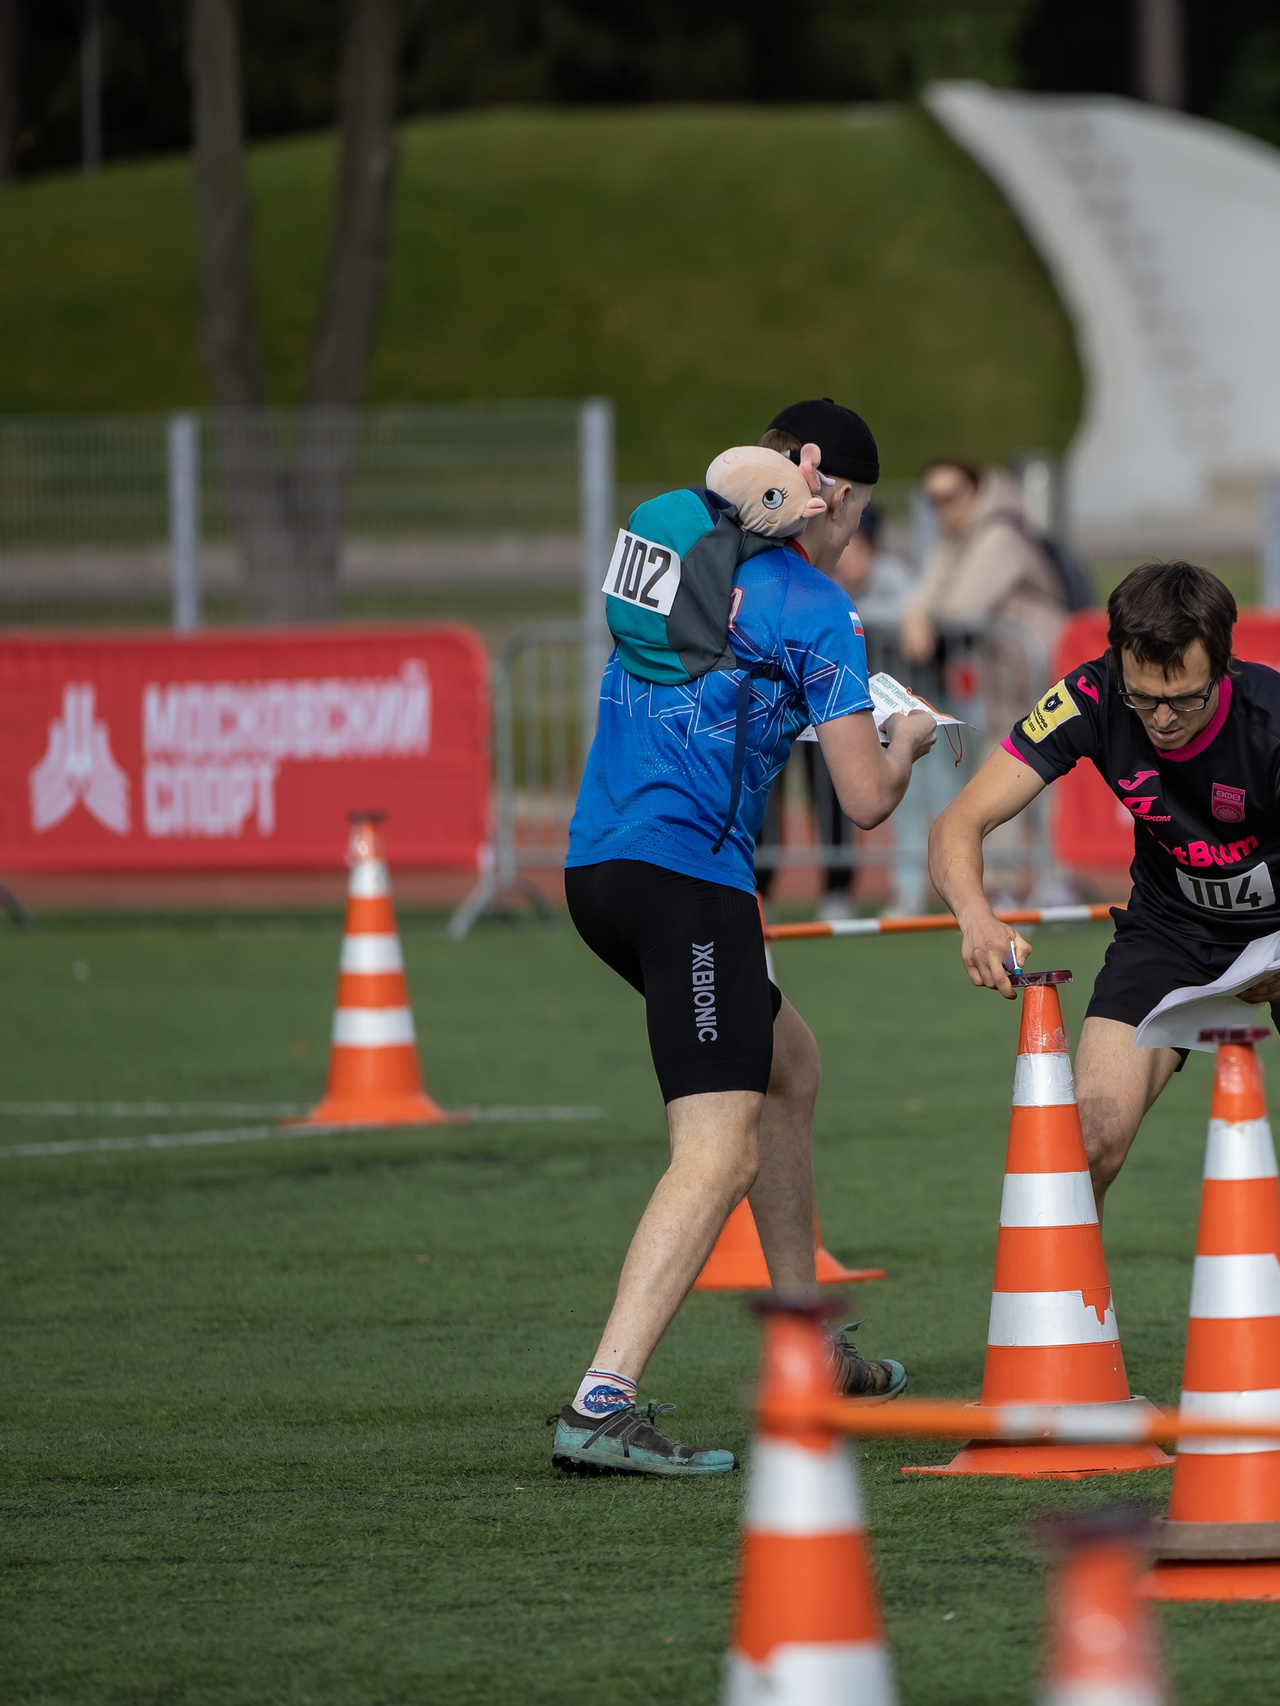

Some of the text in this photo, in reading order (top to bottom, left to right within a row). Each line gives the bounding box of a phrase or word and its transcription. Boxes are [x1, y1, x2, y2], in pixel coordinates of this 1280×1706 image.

[613, 535, 671, 608] 102
[144, 659, 430, 758] МОСКОВСКИЙ
[876, 674, 918, 708] СПОРТИВНЫЙ
[144, 759, 278, 838] СПОРТ
[1188, 874, 1262, 909] 104
[586, 1394, 629, 1407] NASA
